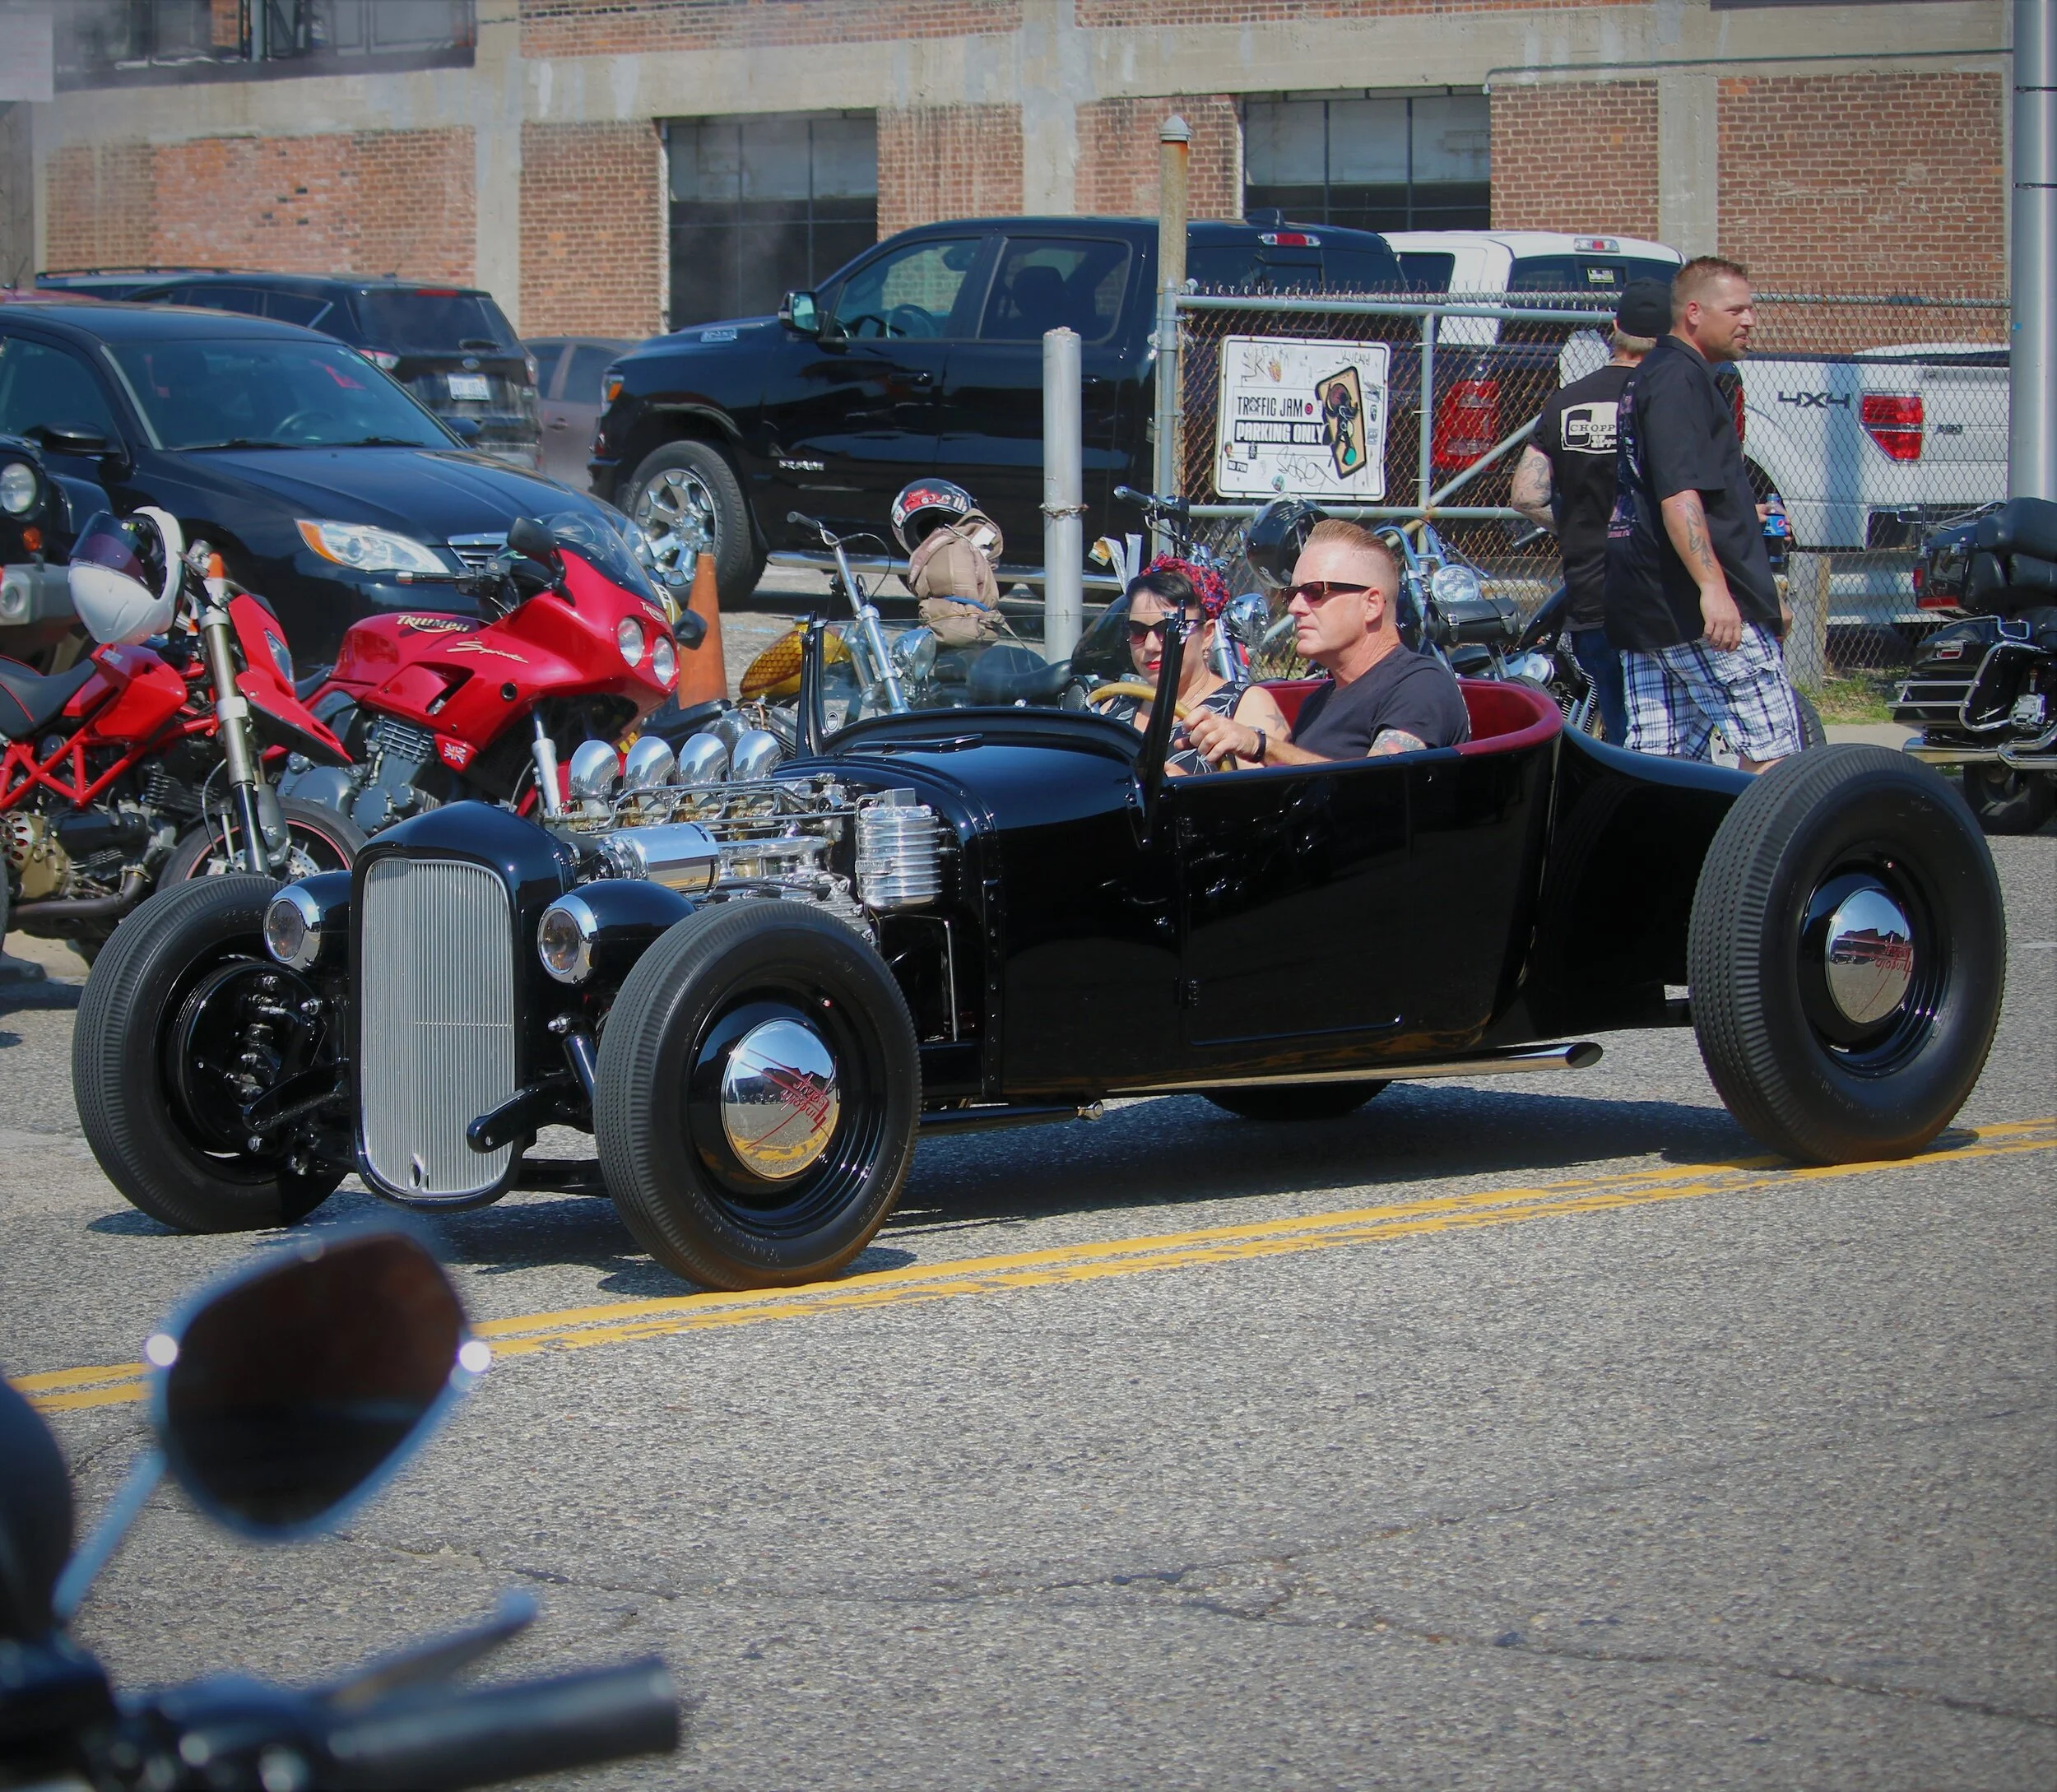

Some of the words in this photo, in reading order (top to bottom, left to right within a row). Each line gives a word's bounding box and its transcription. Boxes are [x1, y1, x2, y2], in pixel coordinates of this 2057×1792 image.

[1237, 397, 1276, 416] TRFFIC
[1279, 398, 1302, 417] JAM
[1778, 391, 1850, 409] 4X4
[1236, 421, 1291, 443] PARKING
[1293, 424, 1326, 443] ONLY
[397, 615, 470, 633] TRIUMPH
[446, 640, 529, 664] Sprint
